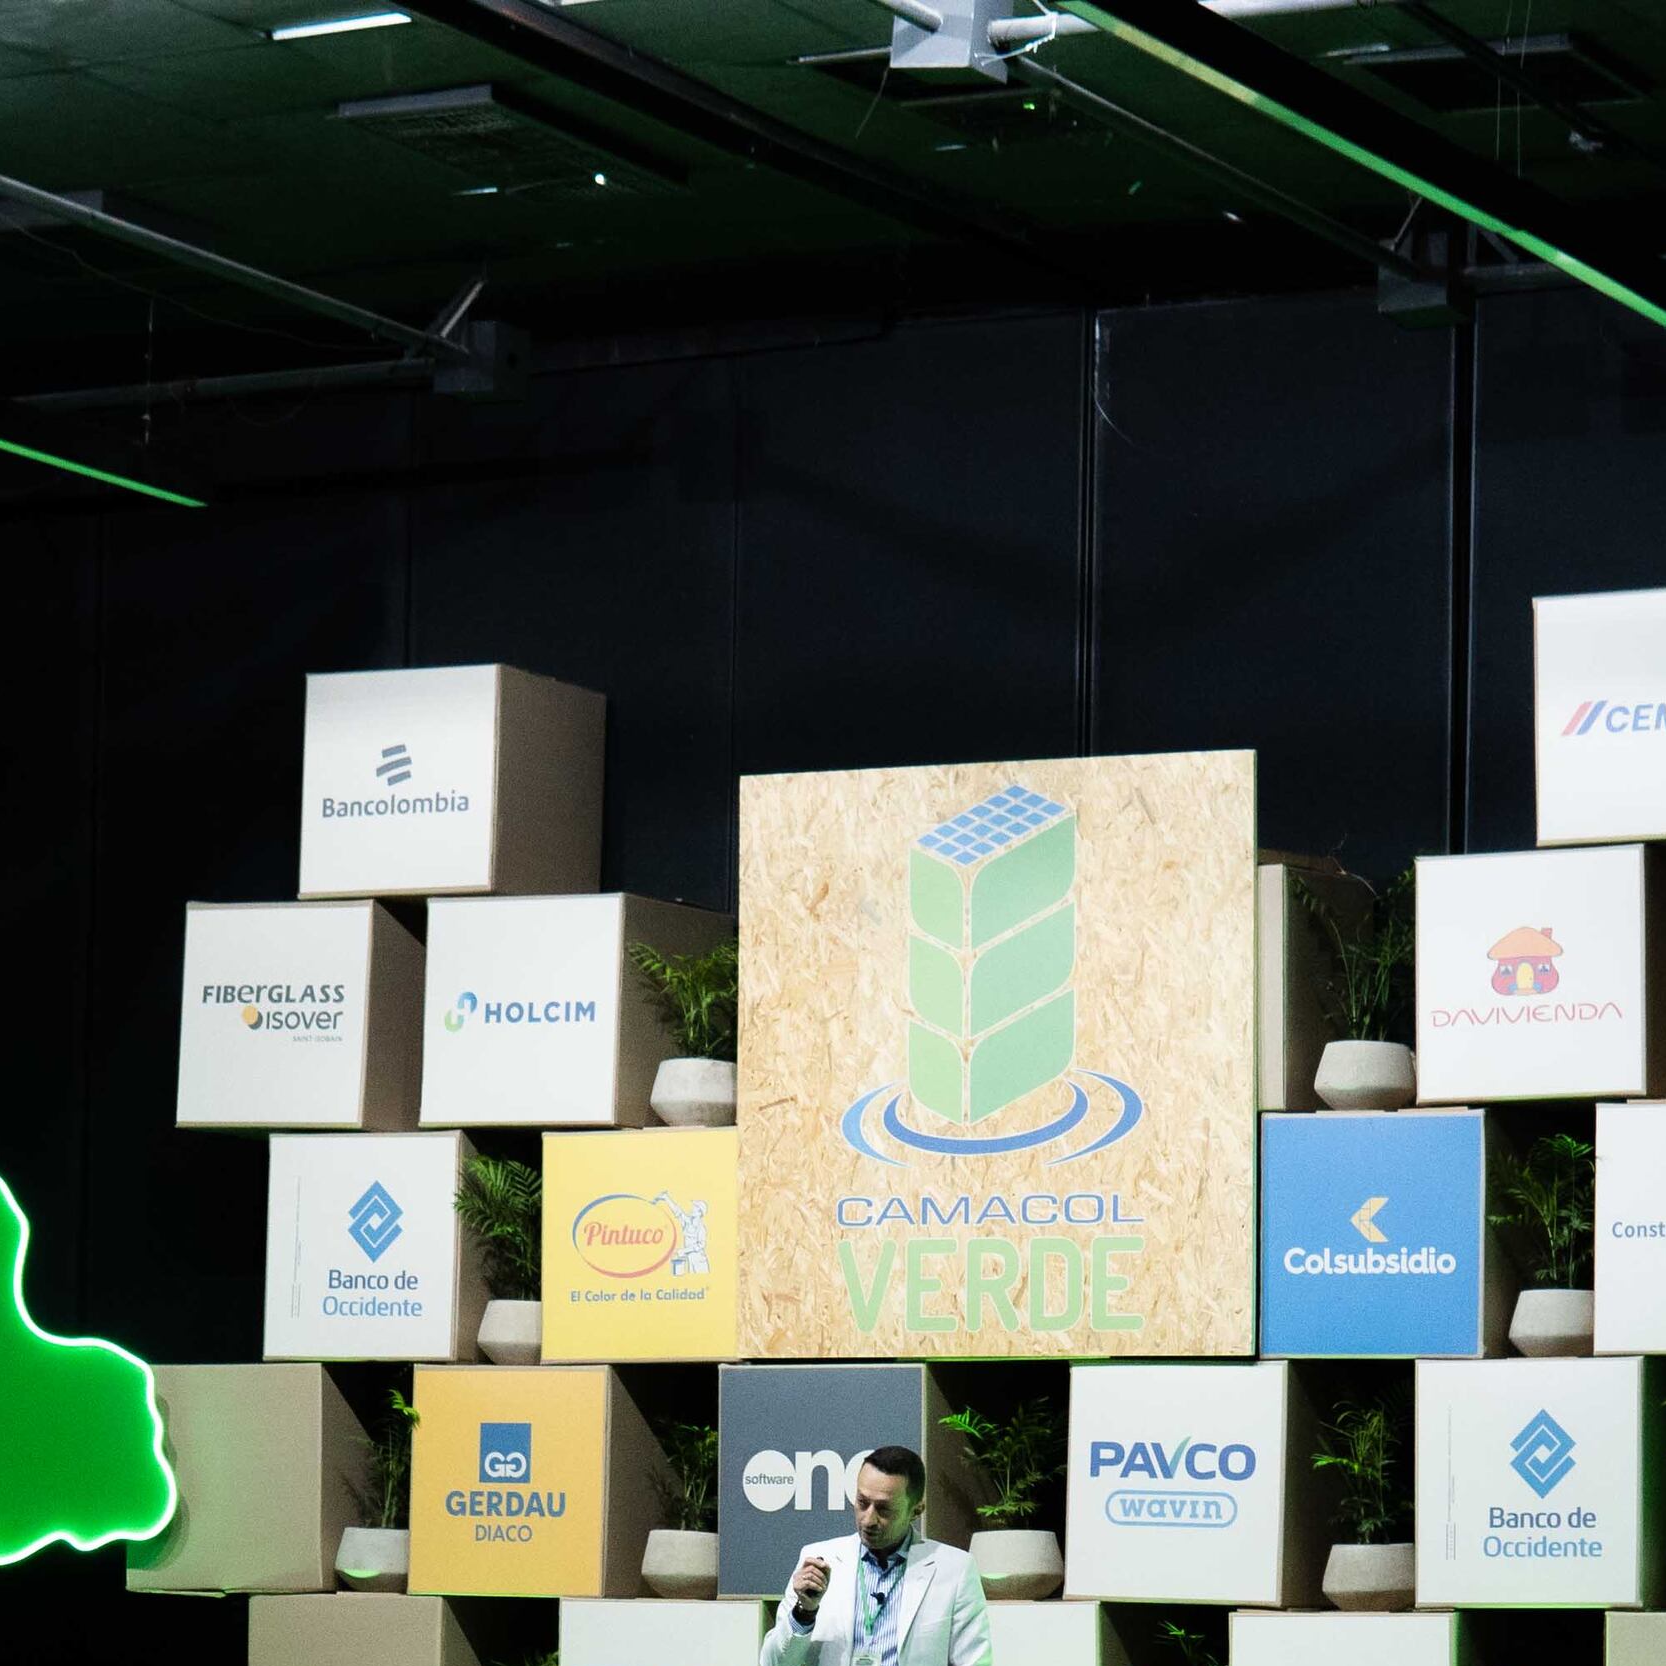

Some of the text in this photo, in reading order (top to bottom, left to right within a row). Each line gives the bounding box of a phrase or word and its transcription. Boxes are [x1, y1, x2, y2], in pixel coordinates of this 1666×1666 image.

[322, 790, 470, 818] Bancolombia
[484, 1001, 596, 1024] HOLCIM
[1432, 1002, 1623, 1028] DAVIVIENDA
[836, 1194, 1144, 1227] CAMACOL
[583, 1221, 664, 1247] Pintuco
[1284, 1247, 1456, 1275] Colsubsidio
[328, 1269, 418, 1290] Banco de
[838, 1236, 1145, 1333] VERDE
[322, 1296, 423, 1317] Occidente
[571, 1291, 581, 1302] El
[585, 1290, 616, 1302] Color
[621, 1290, 636, 1301] de
[640, 1289, 652, 1300] la
[1090, 1437, 1256, 1480] PAVCO
[745, 1473, 794, 1485] software
[445, 1490, 566, 1518] GERDAU
[1120, 1495, 1223, 1520] wavin
[1488, 1507, 1596, 1529] Banco de
[475, 1524, 533, 1542] DIACO
[1483, 1537, 1603, 1558] Occidente
